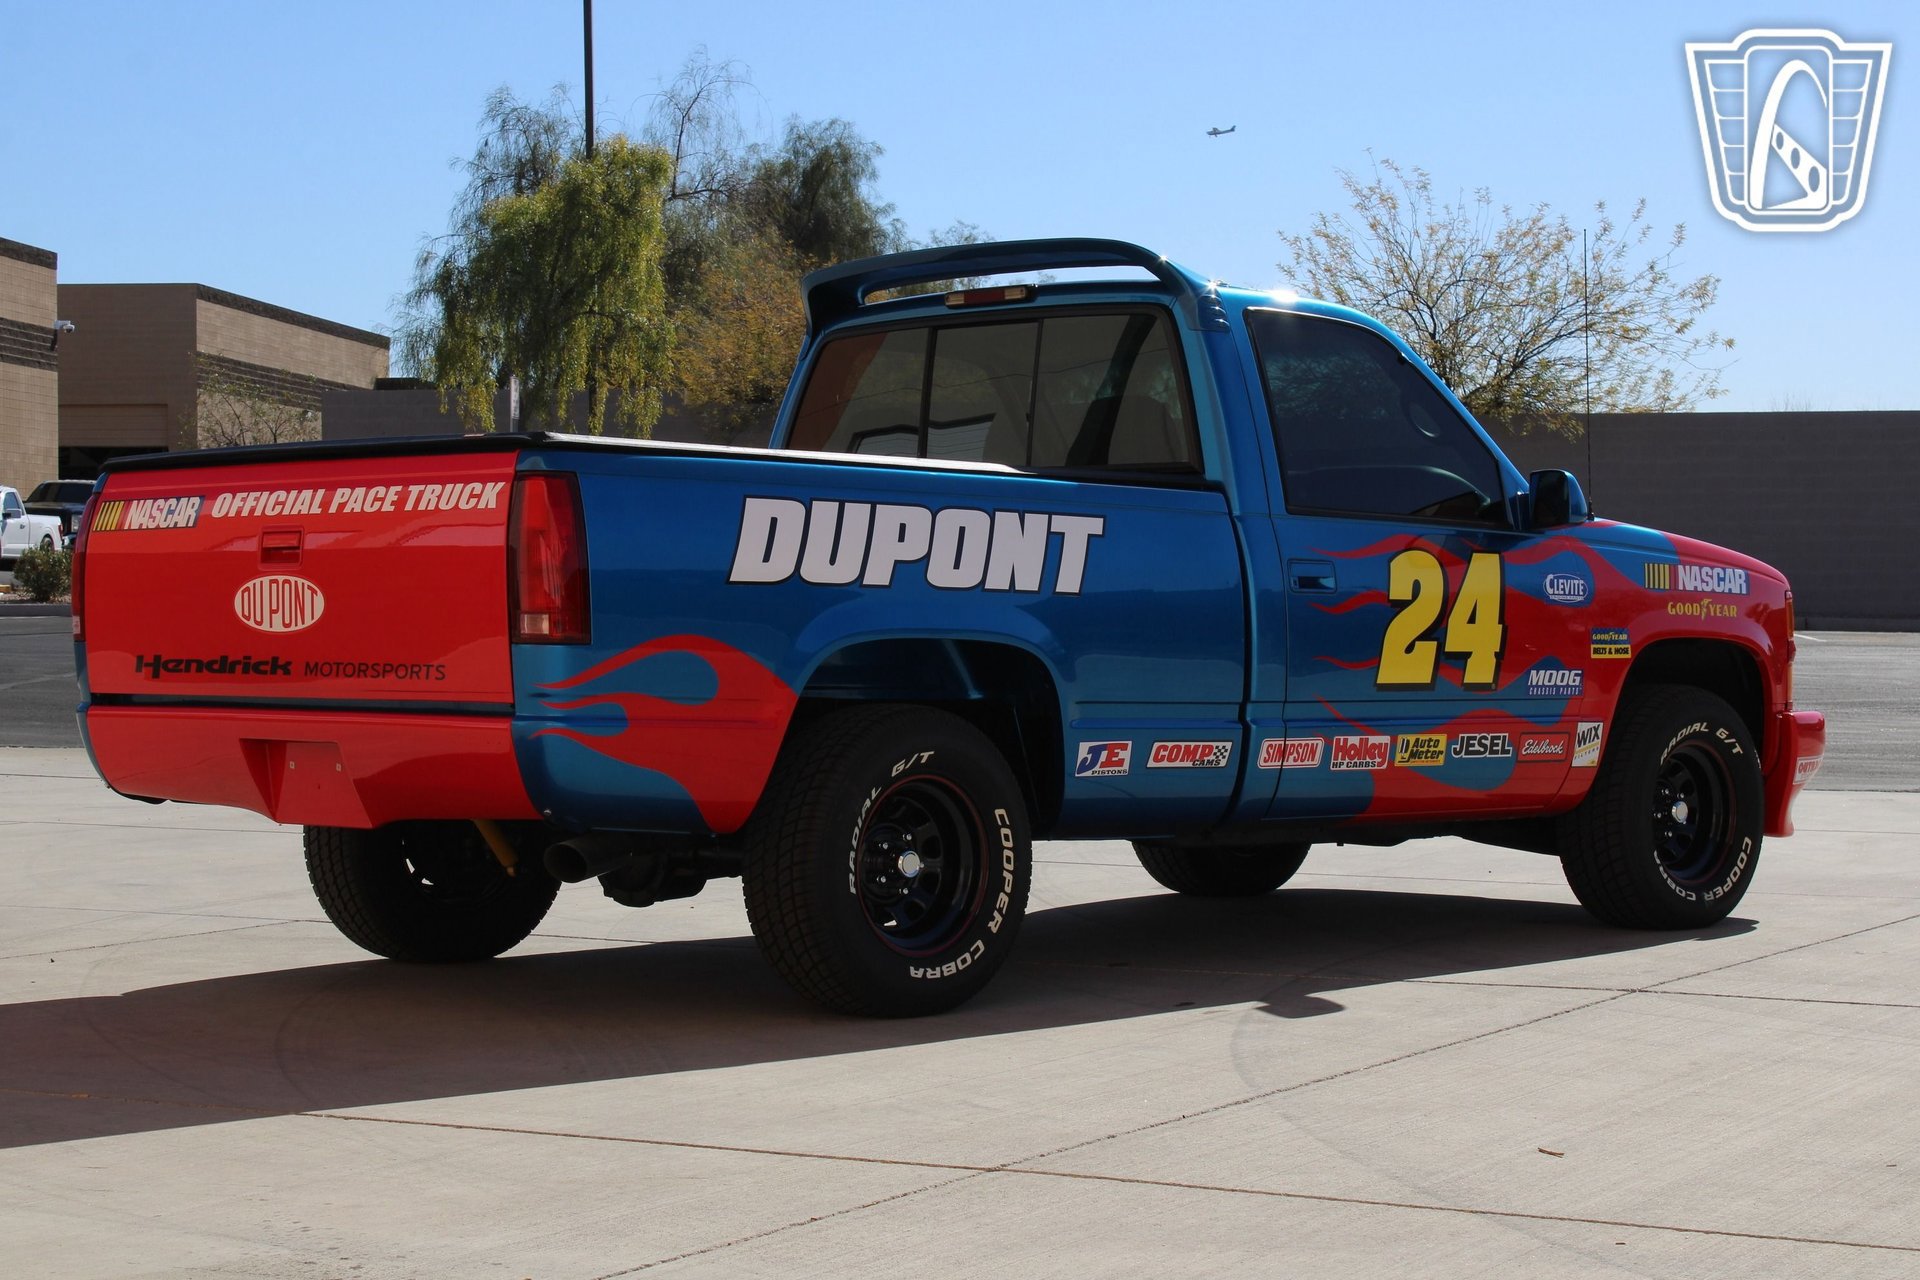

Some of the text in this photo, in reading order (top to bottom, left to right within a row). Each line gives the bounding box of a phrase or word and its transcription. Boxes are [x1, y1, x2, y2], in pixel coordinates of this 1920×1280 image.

[210, 481, 506, 518] OFFICIAL PACE TRUCK
[123, 496, 201, 530] NASCAR
[728, 495, 1105, 596] DUPONT
[1546, 574, 1584, 596] CLEVITE
[1677, 564, 1748, 595] NASCAR
[1375, 548, 1505, 688] 24
[1614, 646, 1630, 655] HOSE
[135, 654, 446, 682] Hendrick MOTORSPORTS
[1528, 669, 1582, 686] MOOG
[1412, 737, 1441, 749] Auto
[1453, 733, 1511, 757] JESEL
[1522, 738, 1565, 756] Edelbrock
[1577, 723, 1601, 748] WIX
[1660, 721, 1744, 766] RADIAL G/T
[1076, 742, 1129, 775] JE
[1152, 743, 1215, 764] COMP
[1192, 758, 1221, 767] CAMS
[1263, 740, 1319, 765] SIMPSON
[1332, 760, 1377, 769] HP CARBS
[1333, 737, 1390, 767] Holley
[1409, 748, 1445, 760] Meter
[1091, 768, 1128, 776] PISTONS
[849, 751, 935, 895] RADIAL G/T
[1704, 836, 1752, 901] COOPER
[909, 808, 1015, 979] COOPER COBRA
